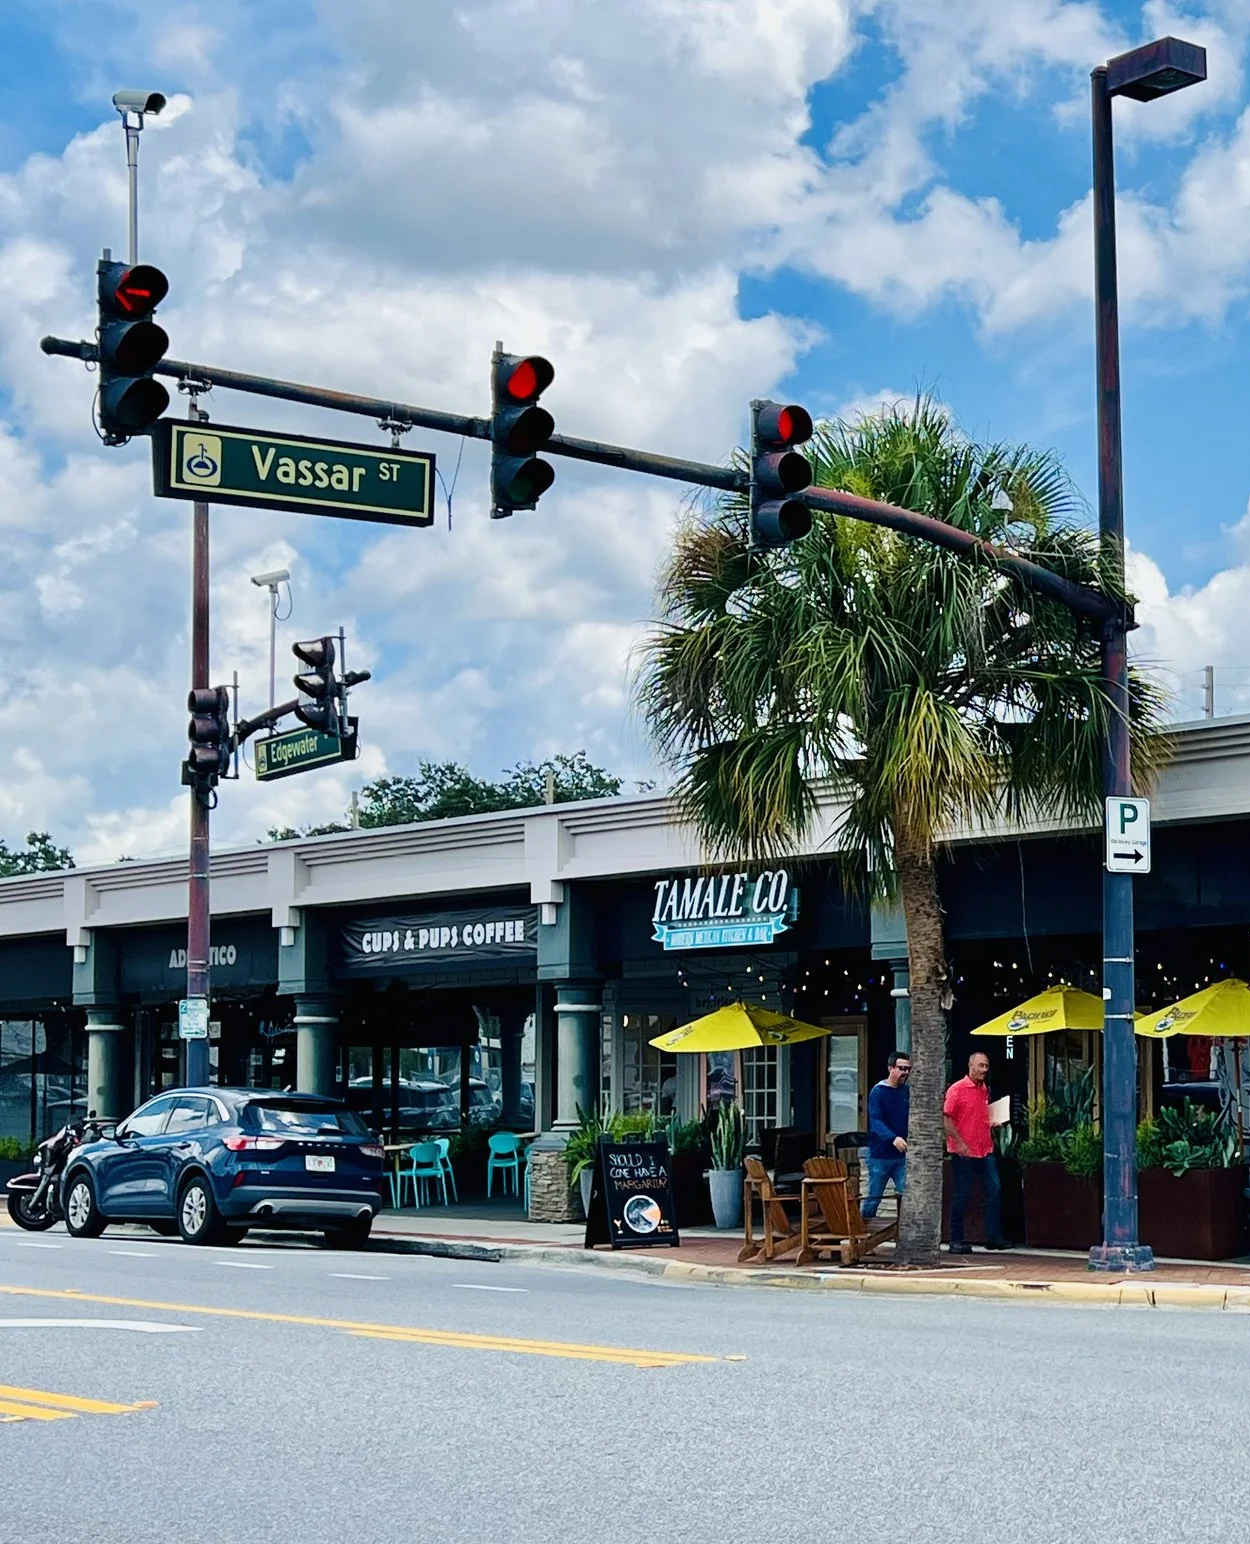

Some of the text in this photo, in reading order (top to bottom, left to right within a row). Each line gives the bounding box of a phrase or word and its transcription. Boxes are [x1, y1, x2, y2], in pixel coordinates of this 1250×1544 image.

[252, 445, 401, 492] Vassar ST
[271, 734, 318, 765] Edgewater
[1120, 803, 1138, 834] P
[652, 869, 788, 922] TAMALE CO.
[362, 920, 525, 953] CUPS & PUPS COFFEE
[608, 1153, 643, 1167] SHOULD
[658, 1165, 668, 1177] A
